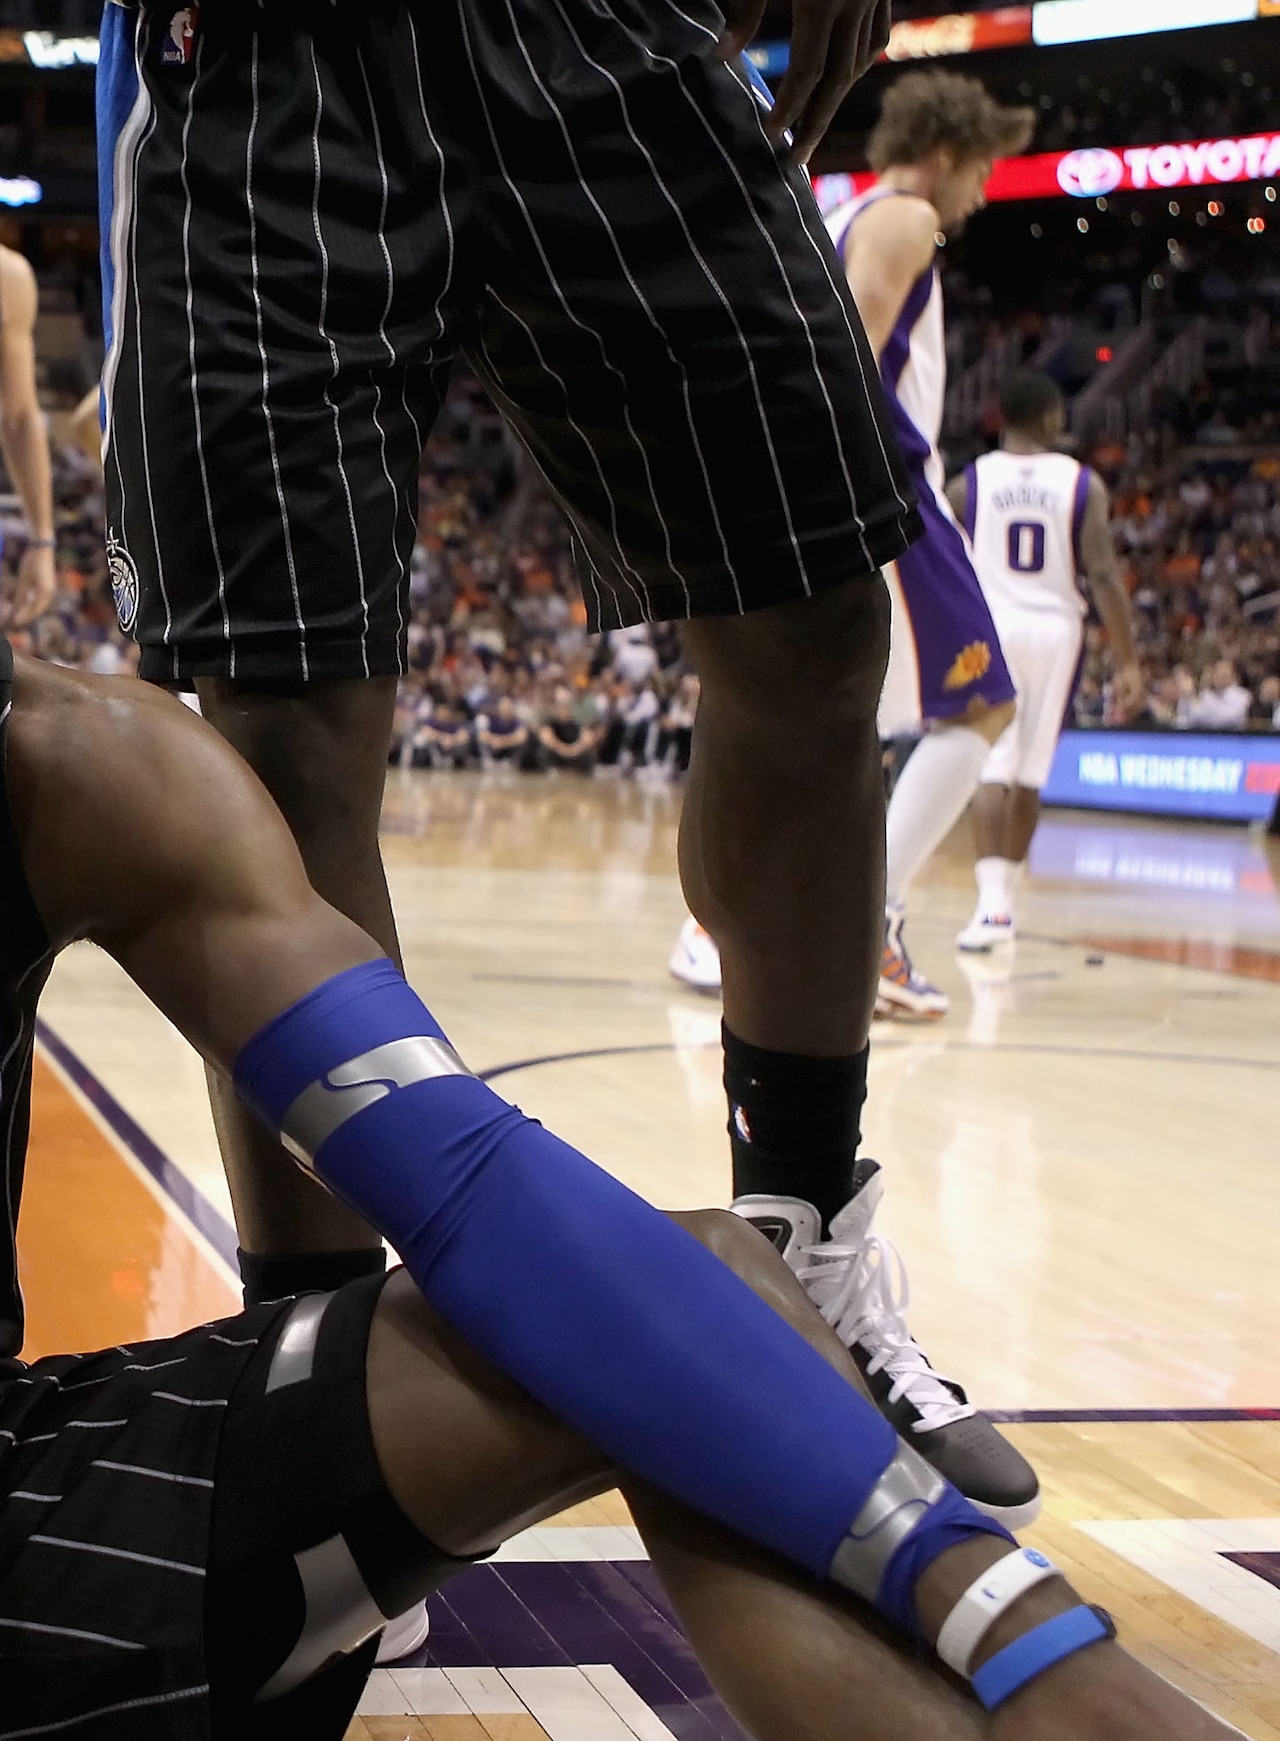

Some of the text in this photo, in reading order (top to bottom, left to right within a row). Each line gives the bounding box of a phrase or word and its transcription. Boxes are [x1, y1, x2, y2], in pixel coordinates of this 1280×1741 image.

[163, 51, 181, 62] NBA
[1007, 521, 1045, 572] 0
[1078, 752, 1118, 787] NBA
[1120, 754, 1244, 794] WEDNESDAY
